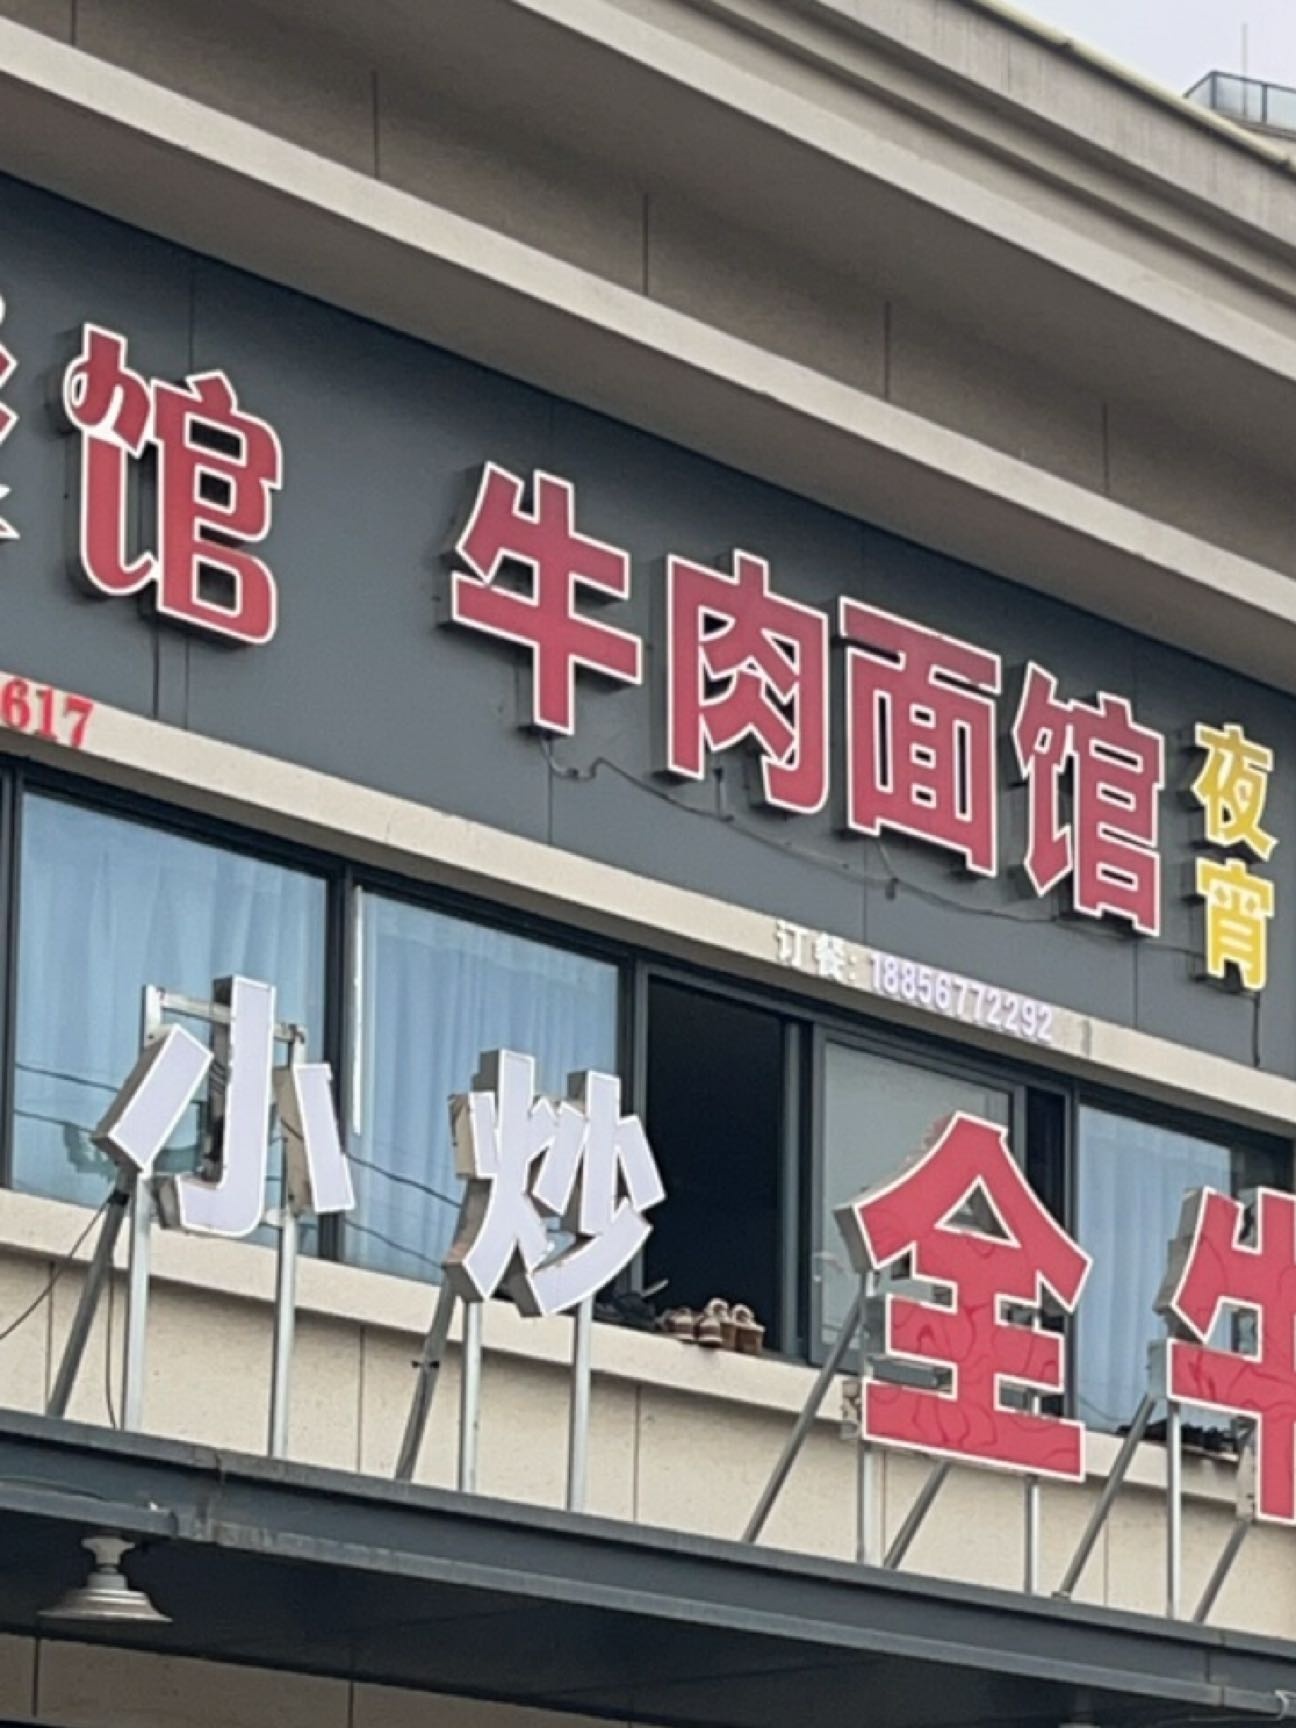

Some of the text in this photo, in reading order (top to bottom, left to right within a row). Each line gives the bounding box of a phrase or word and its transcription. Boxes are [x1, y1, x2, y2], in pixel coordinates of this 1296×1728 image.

[453, 462, 1164, 936] 牛肉面馆
[869, 950, 1053, 1040] 18856772292
[1191, 722, 1277, 990] 夜宵
[107, 975, 666, 1316] 小炒
